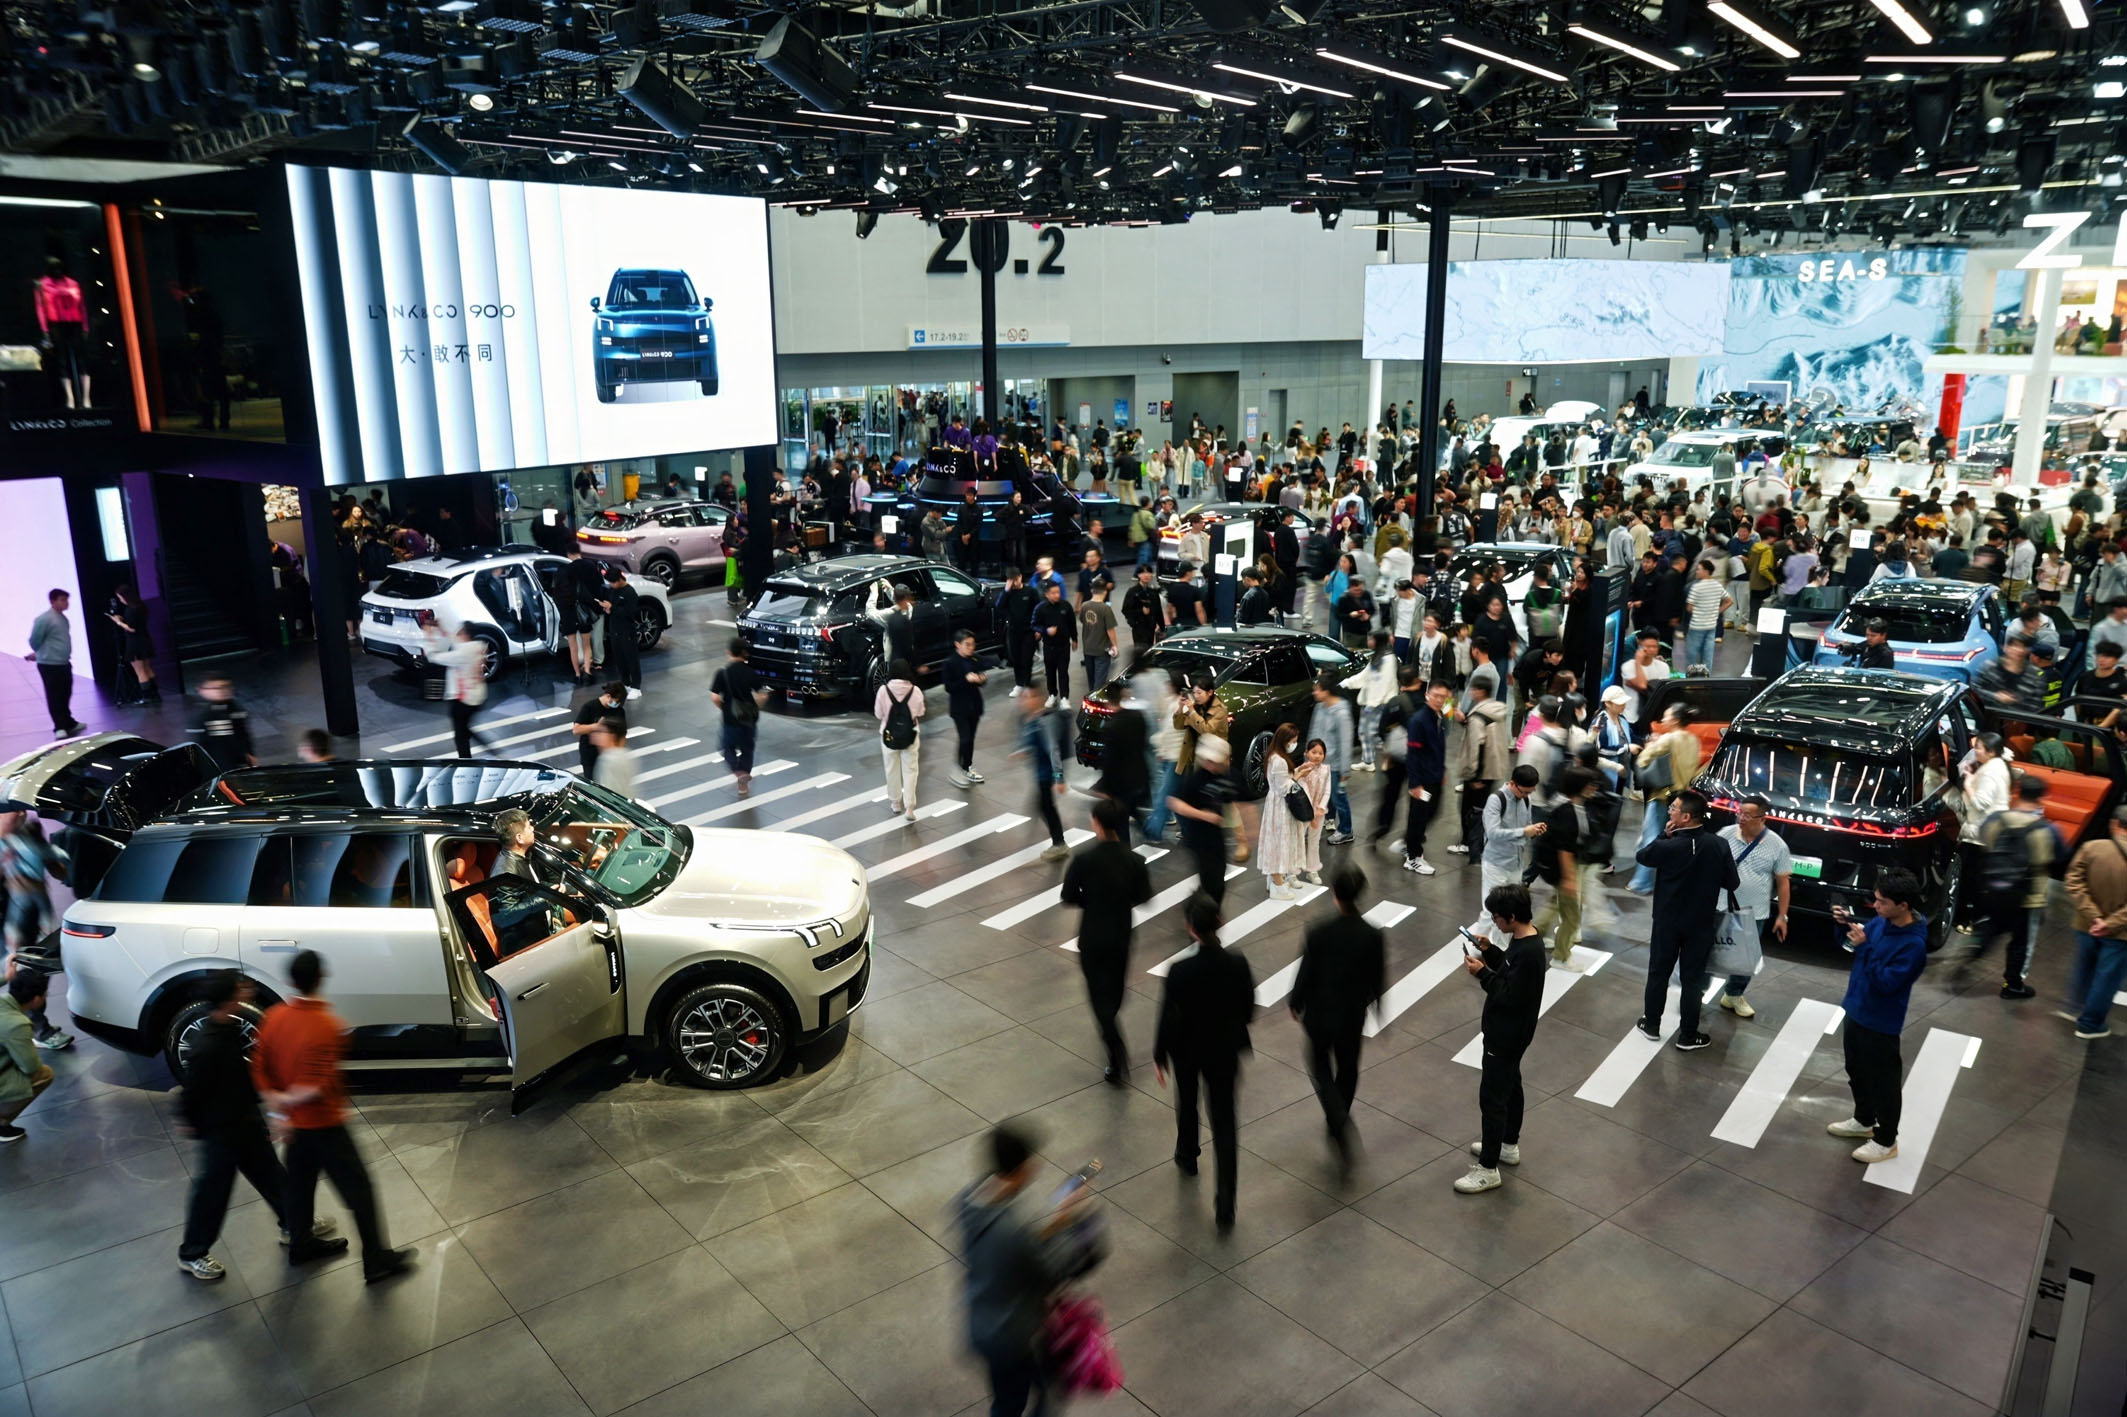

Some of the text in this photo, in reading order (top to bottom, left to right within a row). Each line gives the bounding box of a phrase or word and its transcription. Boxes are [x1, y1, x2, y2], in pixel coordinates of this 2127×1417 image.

[926, 217, 1065, 274] 20.2
[1798, 258, 1887, 283] SEA-S
[469, 304, 516, 319] 900
